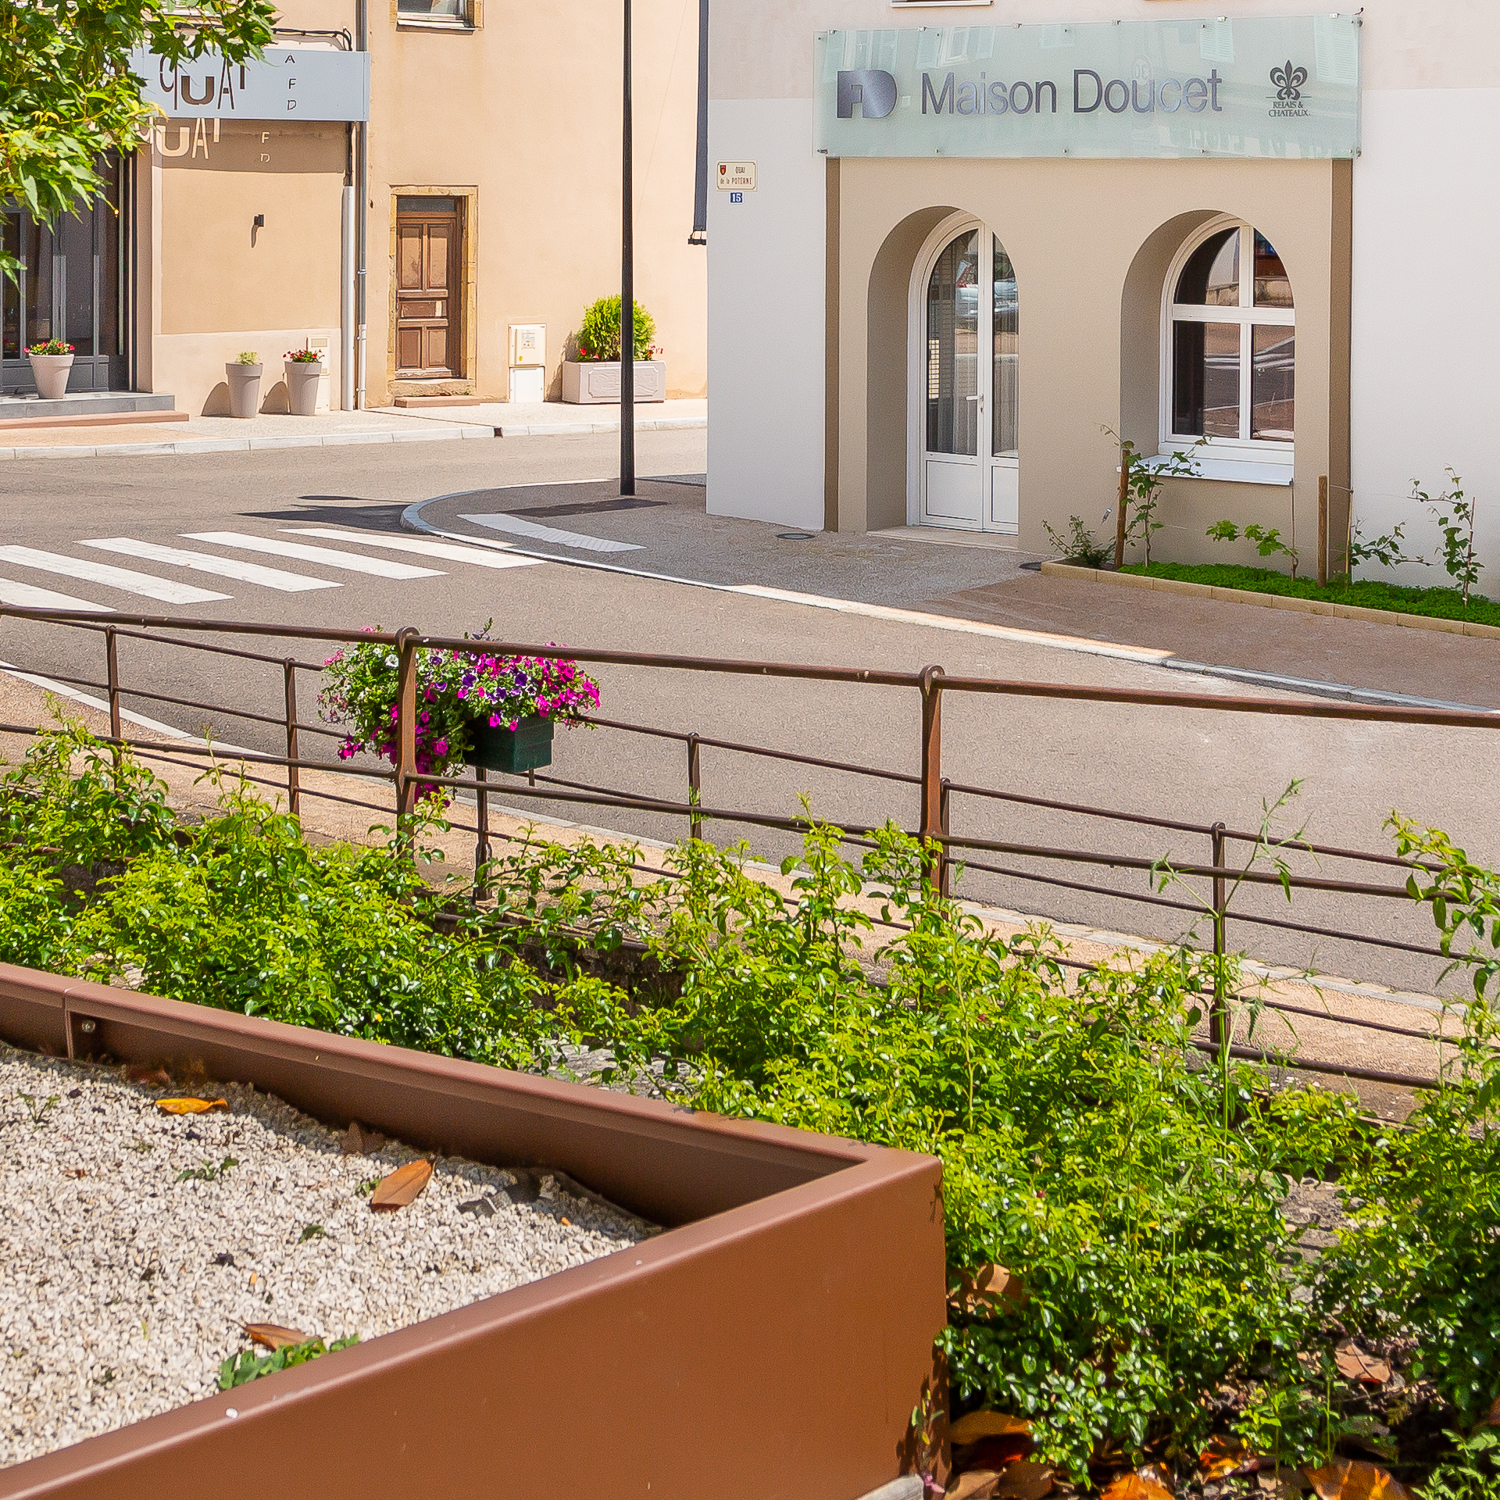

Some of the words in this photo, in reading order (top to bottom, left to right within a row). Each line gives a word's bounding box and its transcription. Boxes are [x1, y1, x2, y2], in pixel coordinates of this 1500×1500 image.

[920, 71, 1057, 115] Maison
[1072, 68, 1224, 115] Doucet
[1272, 101, 1297, 109] RELAIS
[1297, 101, 1304, 109] &
[732, 192, 743, 203] 15
